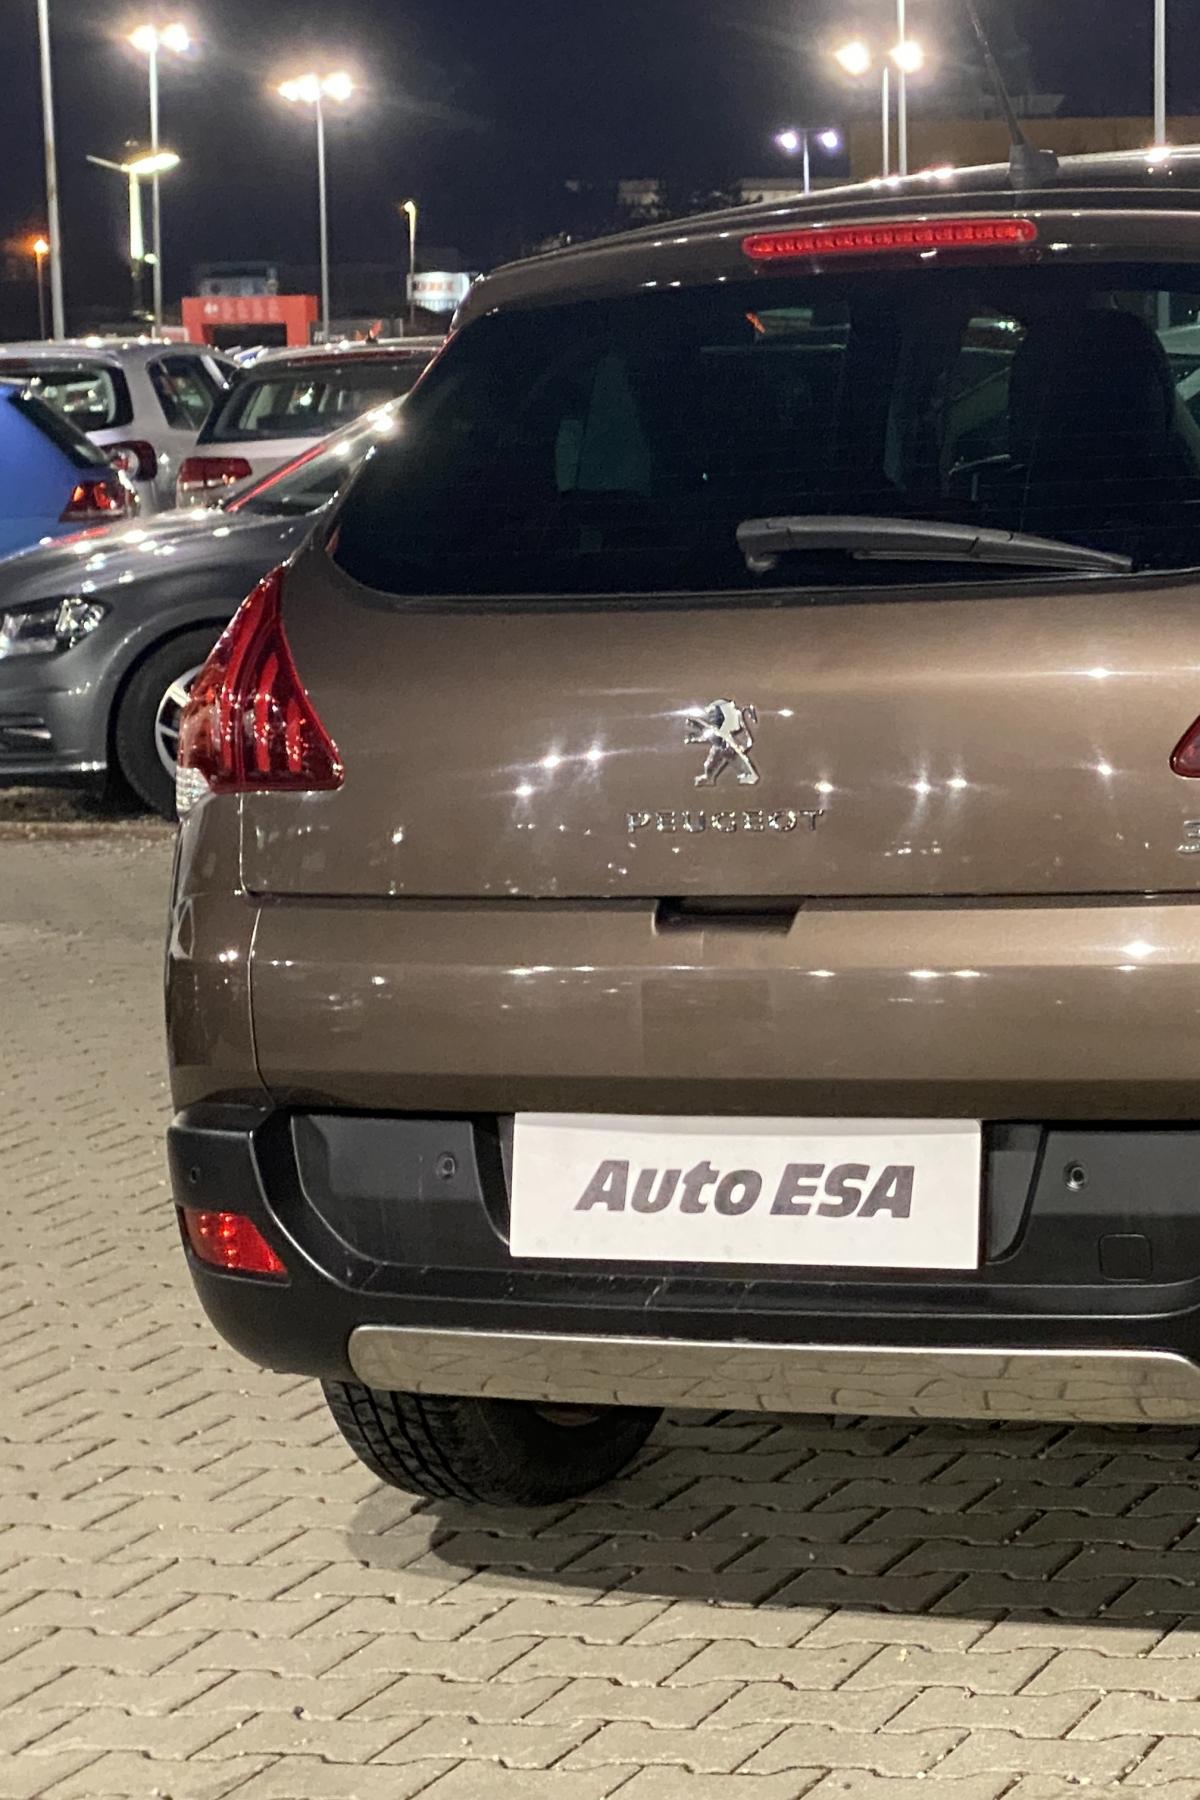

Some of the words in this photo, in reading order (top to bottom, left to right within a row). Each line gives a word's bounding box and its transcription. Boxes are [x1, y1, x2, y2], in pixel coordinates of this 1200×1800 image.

[626, 809, 824, 833] PEUGEOT
[574, 1160, 763, 1215] Auto
[769, 1163, 915, 1218] ESA
